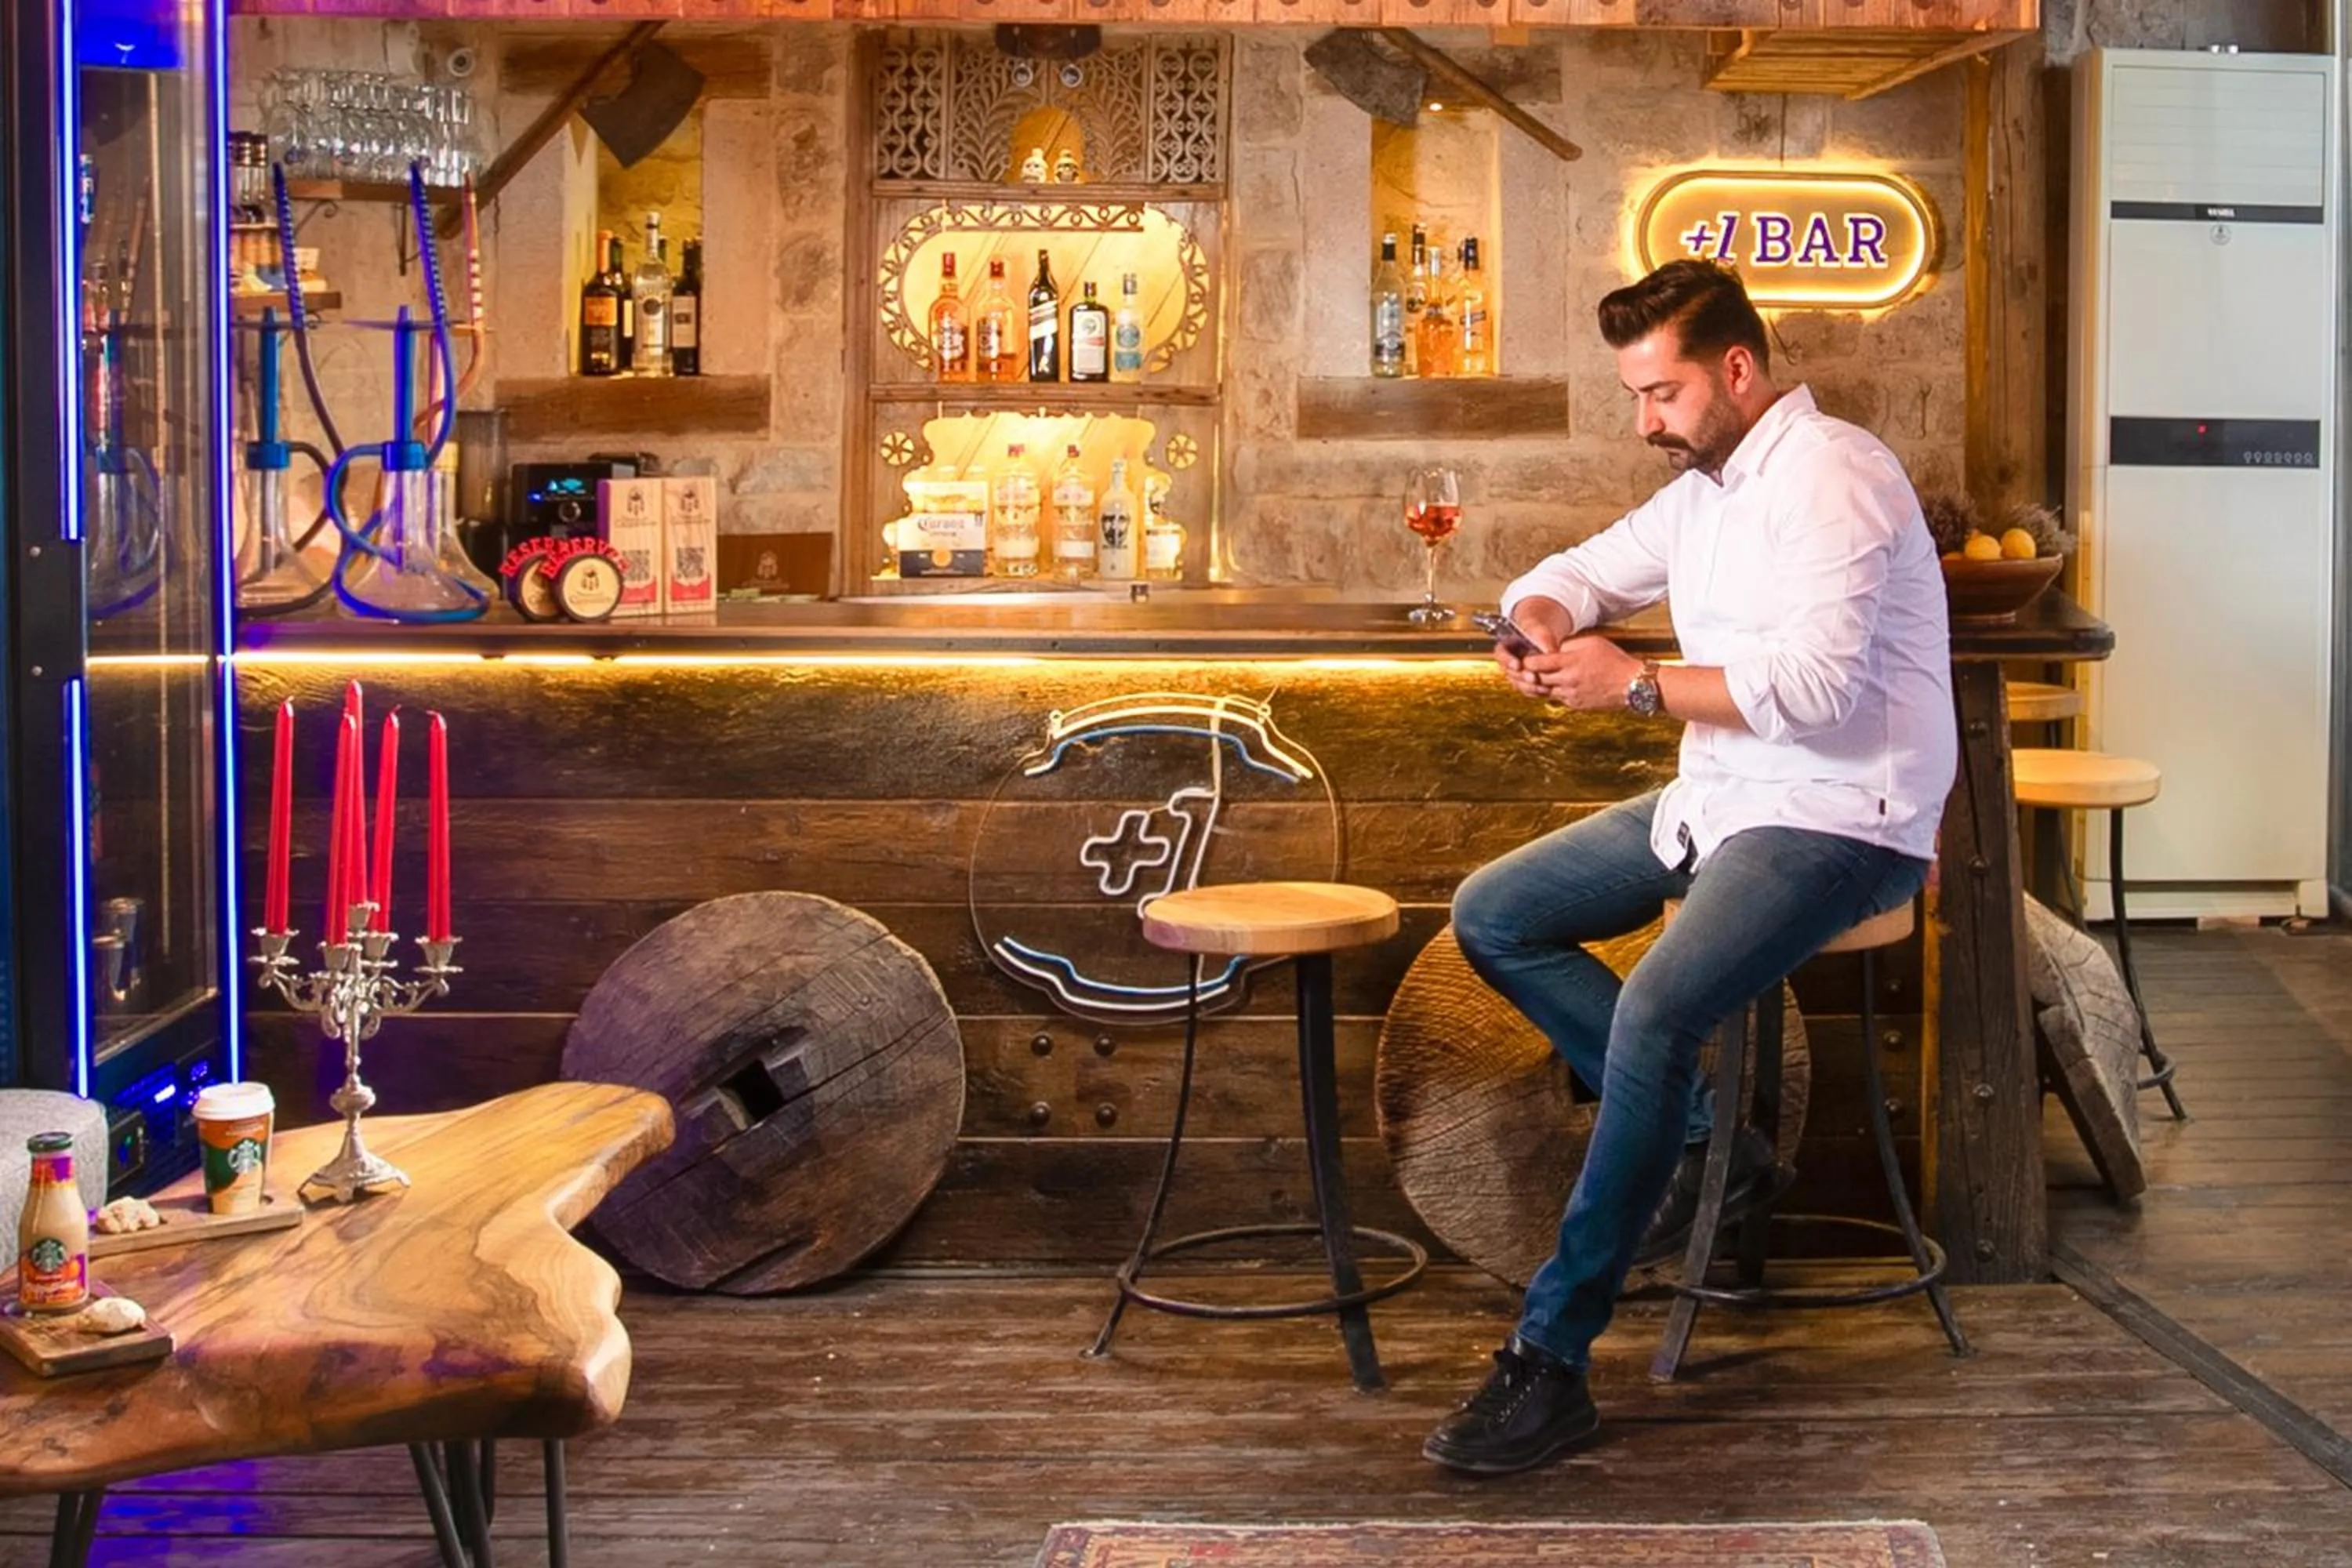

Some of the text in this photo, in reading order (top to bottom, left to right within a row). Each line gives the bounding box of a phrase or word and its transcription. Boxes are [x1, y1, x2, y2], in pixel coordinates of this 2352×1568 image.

[1682, 212, 1887, 265] +1 BAR
[1080, 786, 1220, 919] +1
